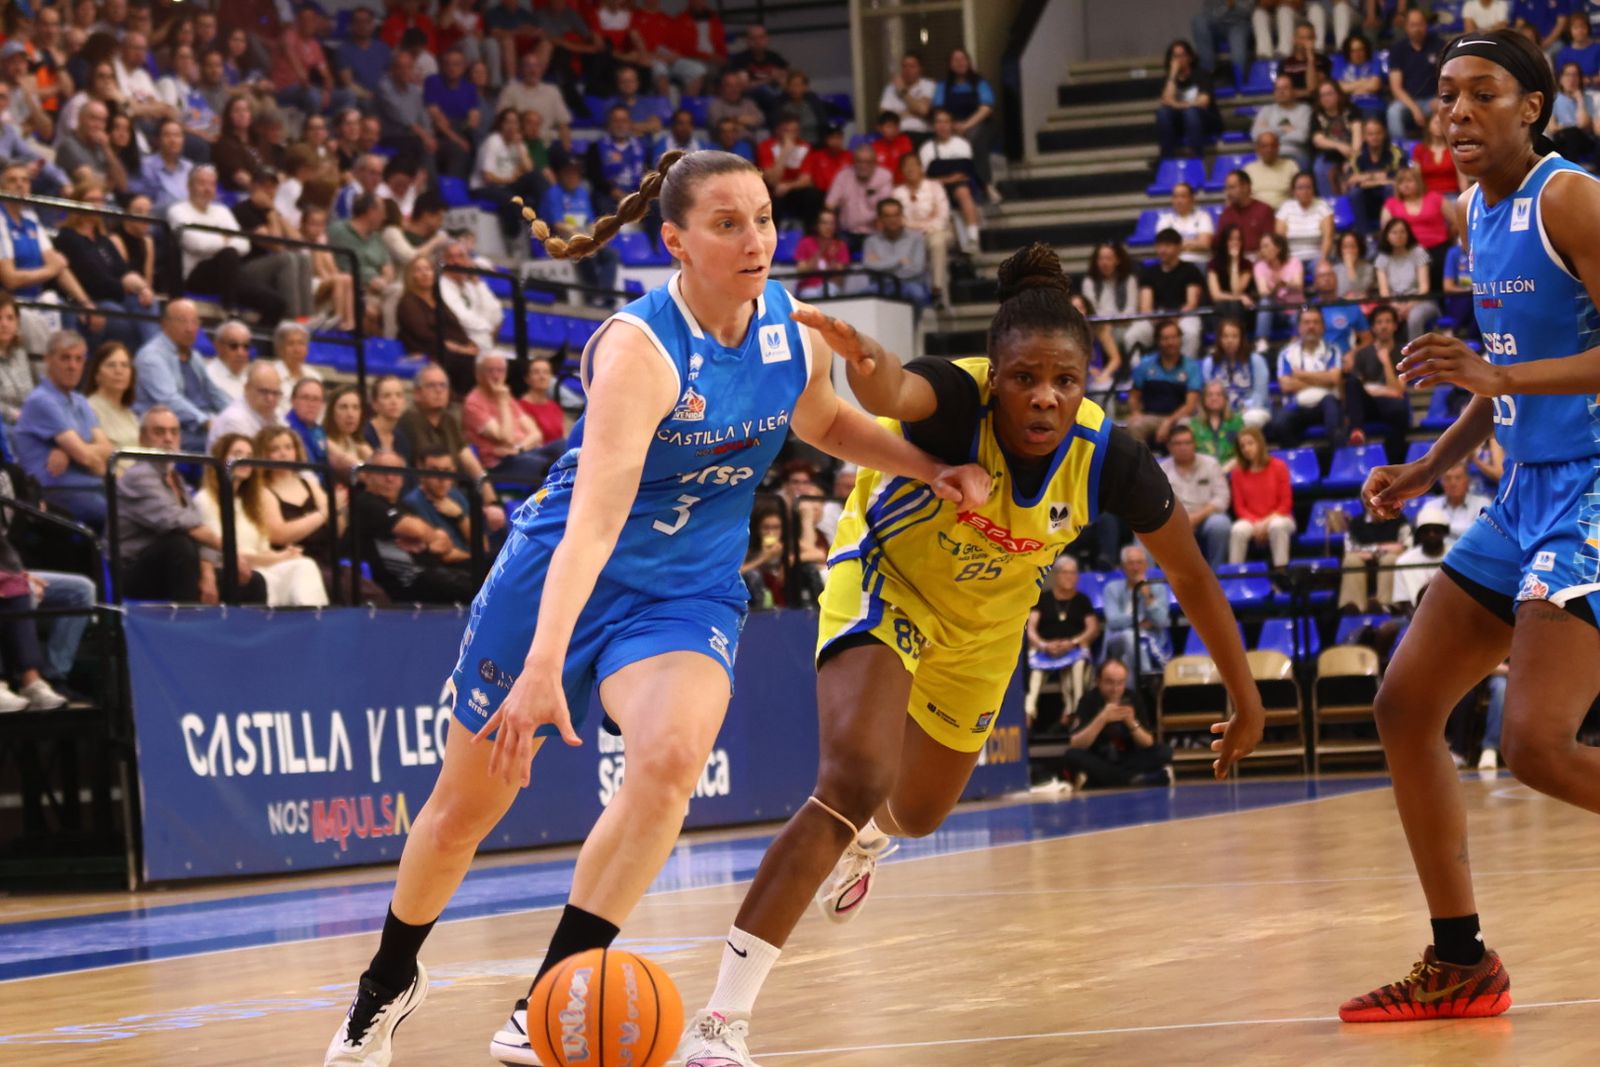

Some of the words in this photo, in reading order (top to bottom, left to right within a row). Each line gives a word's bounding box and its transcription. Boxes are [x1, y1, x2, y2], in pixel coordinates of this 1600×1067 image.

[1490, 280, 1497, 297] Y
[1500, 275, 1536, 294] LEÓN
[657, 426, 735, 447] CASTILLA
[742, 420, 752, 439] Y
[652, 494, 701, 536] 3
[968, 514, 1041, 551] SPAR
[954, 558, 1002, 582] 85
[181, 710, 352, 777] CASTILLA
[366, 708, 386, 783] Y
[396, 676, 456, 766] LEÓ
[268, 801, 309, 835] NOS
[311, 792, 410, 851] IMPULSA
